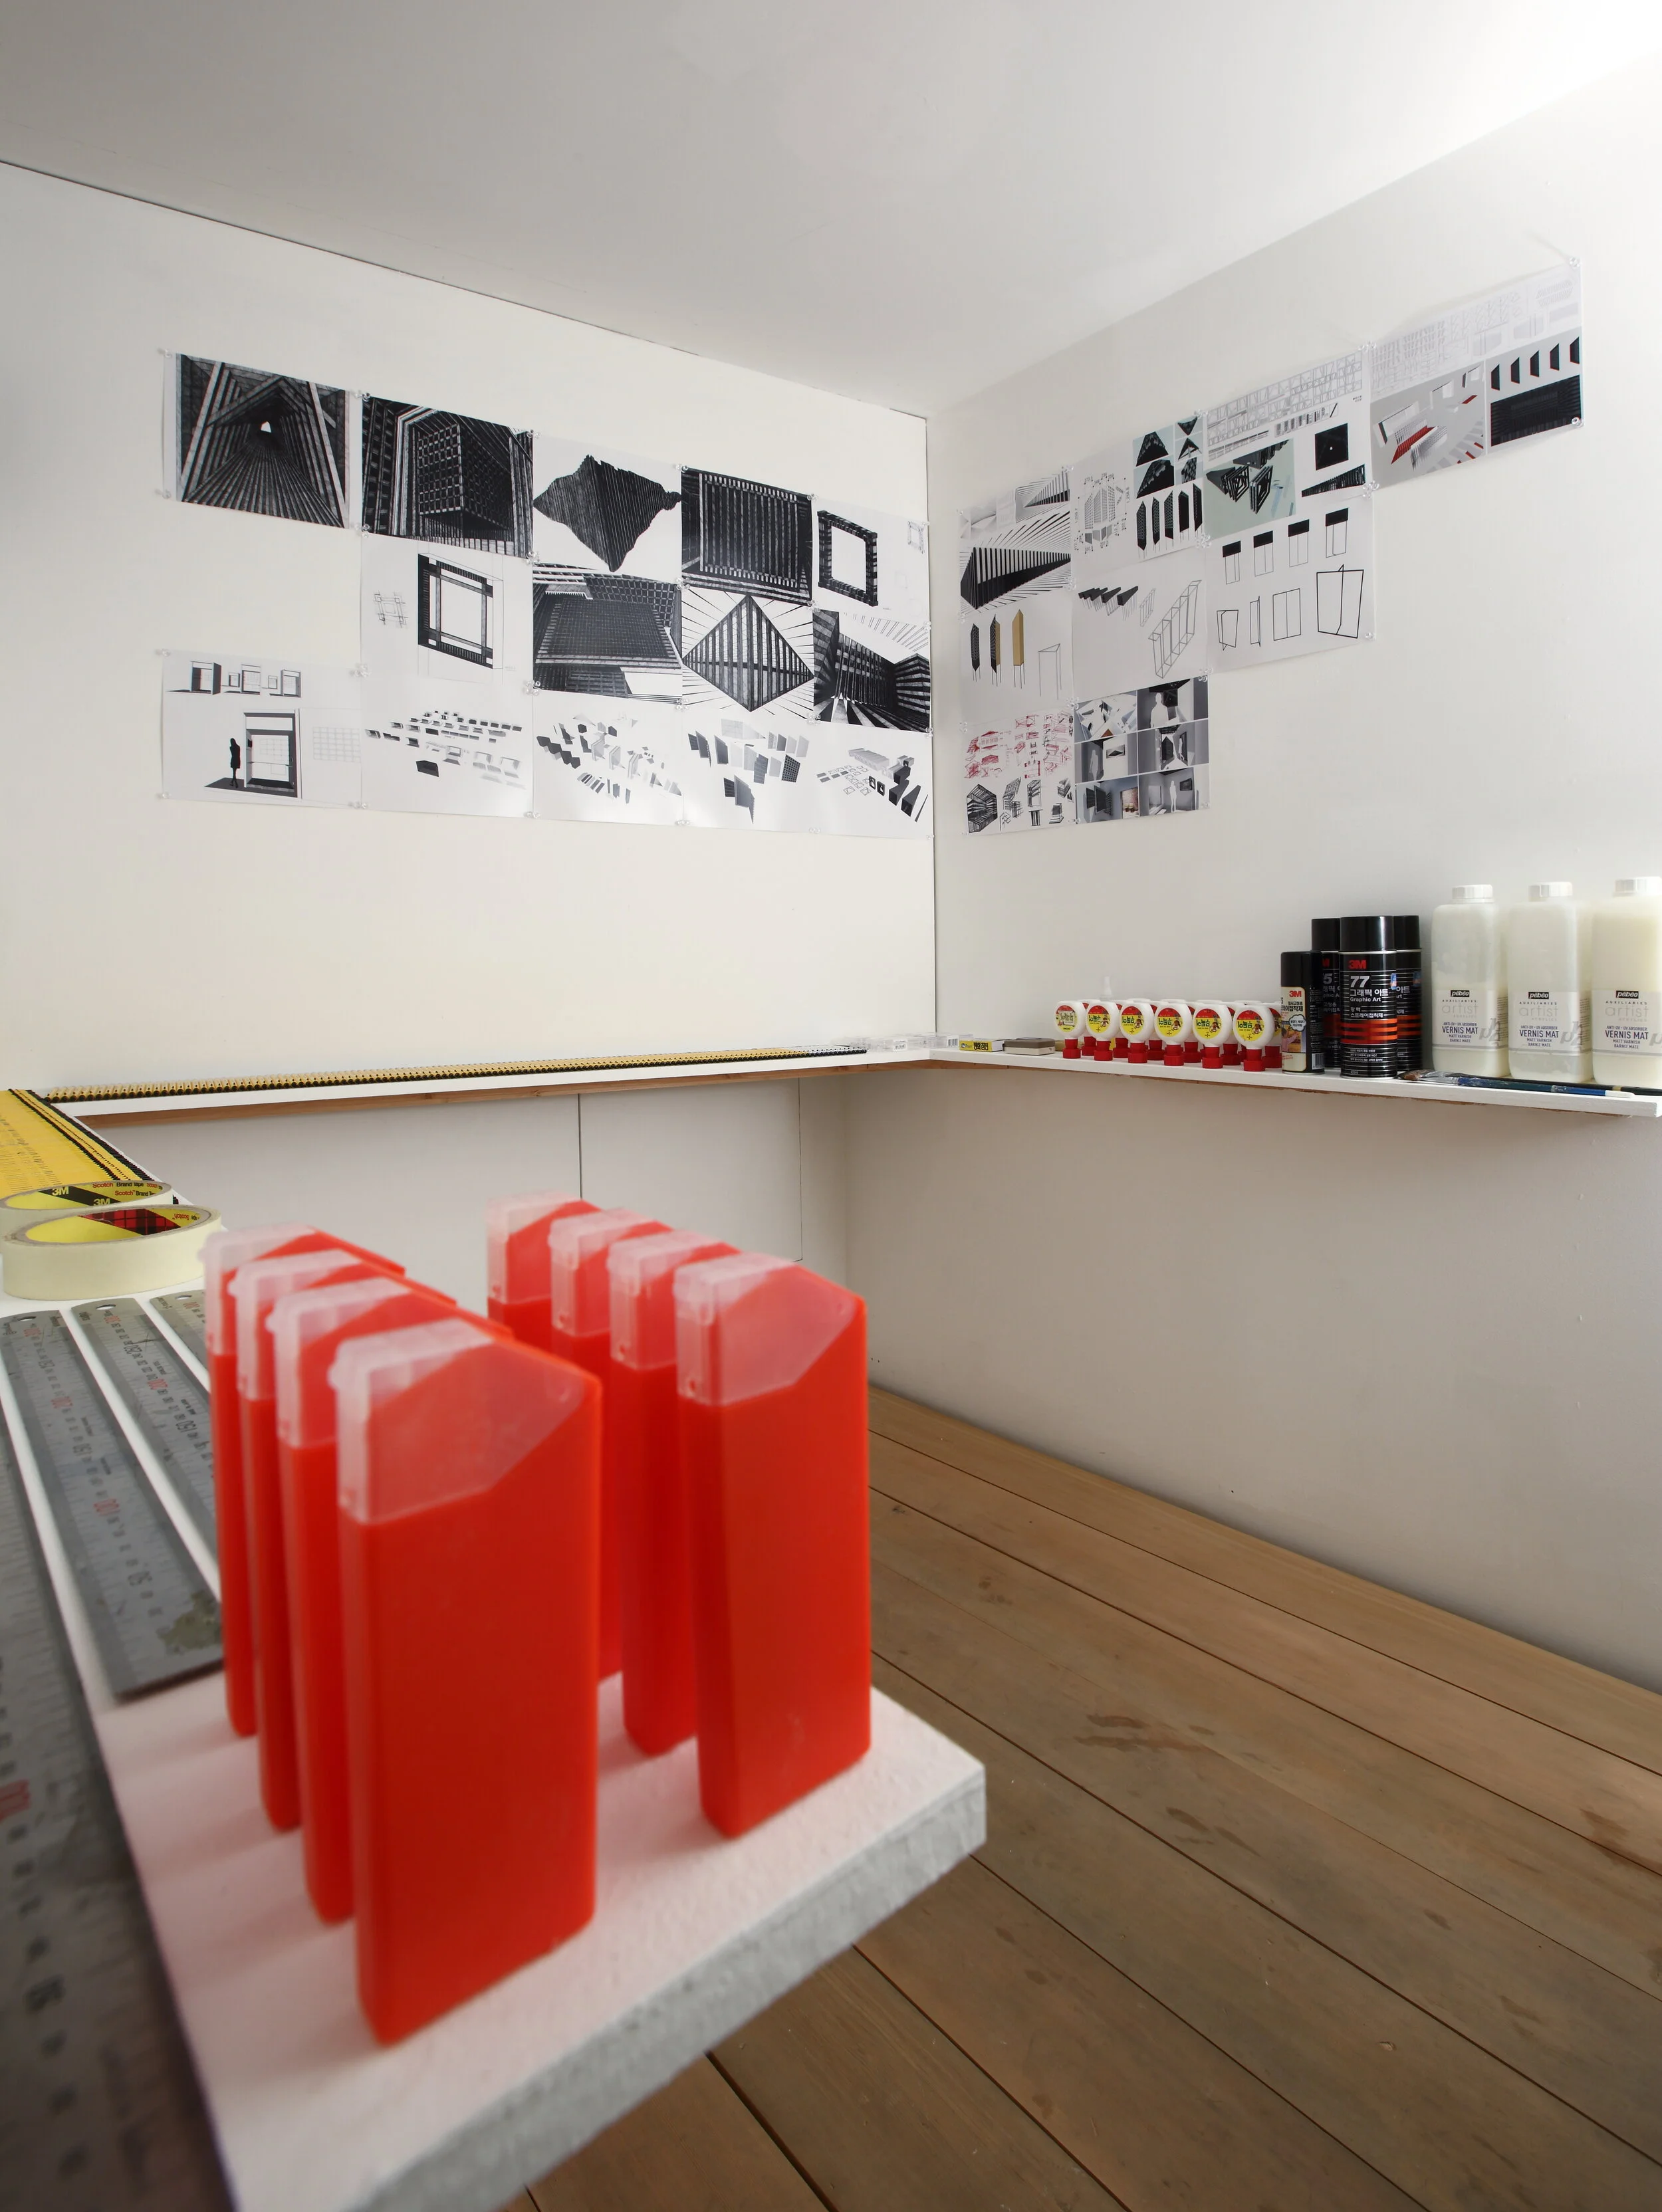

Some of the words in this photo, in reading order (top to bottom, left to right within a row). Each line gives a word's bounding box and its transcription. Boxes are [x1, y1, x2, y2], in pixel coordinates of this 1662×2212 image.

[1349, 960, 1366, 969] 3M
[1350, 976, 1369, 988] 77
[1442, 1003, 1479, 1014] artist
[1519, 1006, 1558, 1017] artist
[1605, 1005, 1649, 1018] artist
[1605, 1030, 1631, 1039] VERNIS
[52, 1186, 69, 1196] 3M
